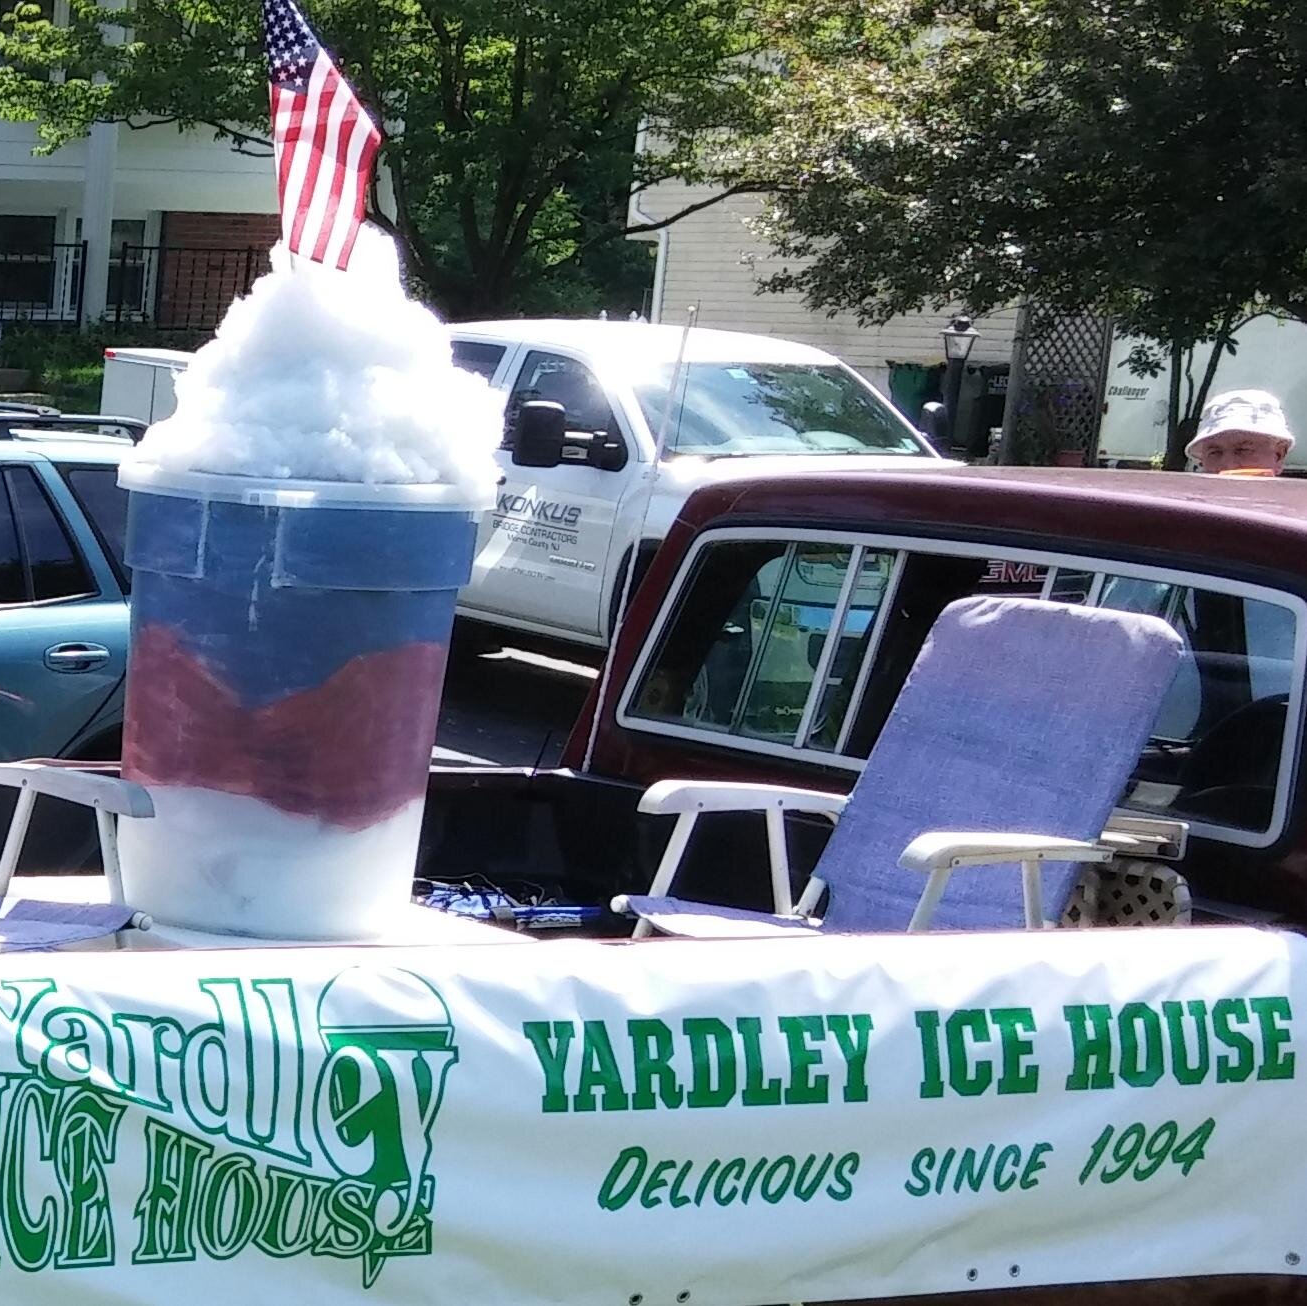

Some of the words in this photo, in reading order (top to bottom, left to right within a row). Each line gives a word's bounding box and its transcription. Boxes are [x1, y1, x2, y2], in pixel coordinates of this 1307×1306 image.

[496, 493, 582, 526] KONKUS
[520, 525, 578, 545] CONTRACTORS
[523, 1012, 875, 1113] YARDLEY
[914, 1006, 1040, 1099] ICE
[1063, 995, 1297, 1092] HOUSE
[131, 1118, 433, 1266] HOUSE
[596, 1144, 861, 1212] DELICIOUS
[903, 1140, 1054, 1198] SINCE
[1077, 1116, 1217, 1187] 1994
